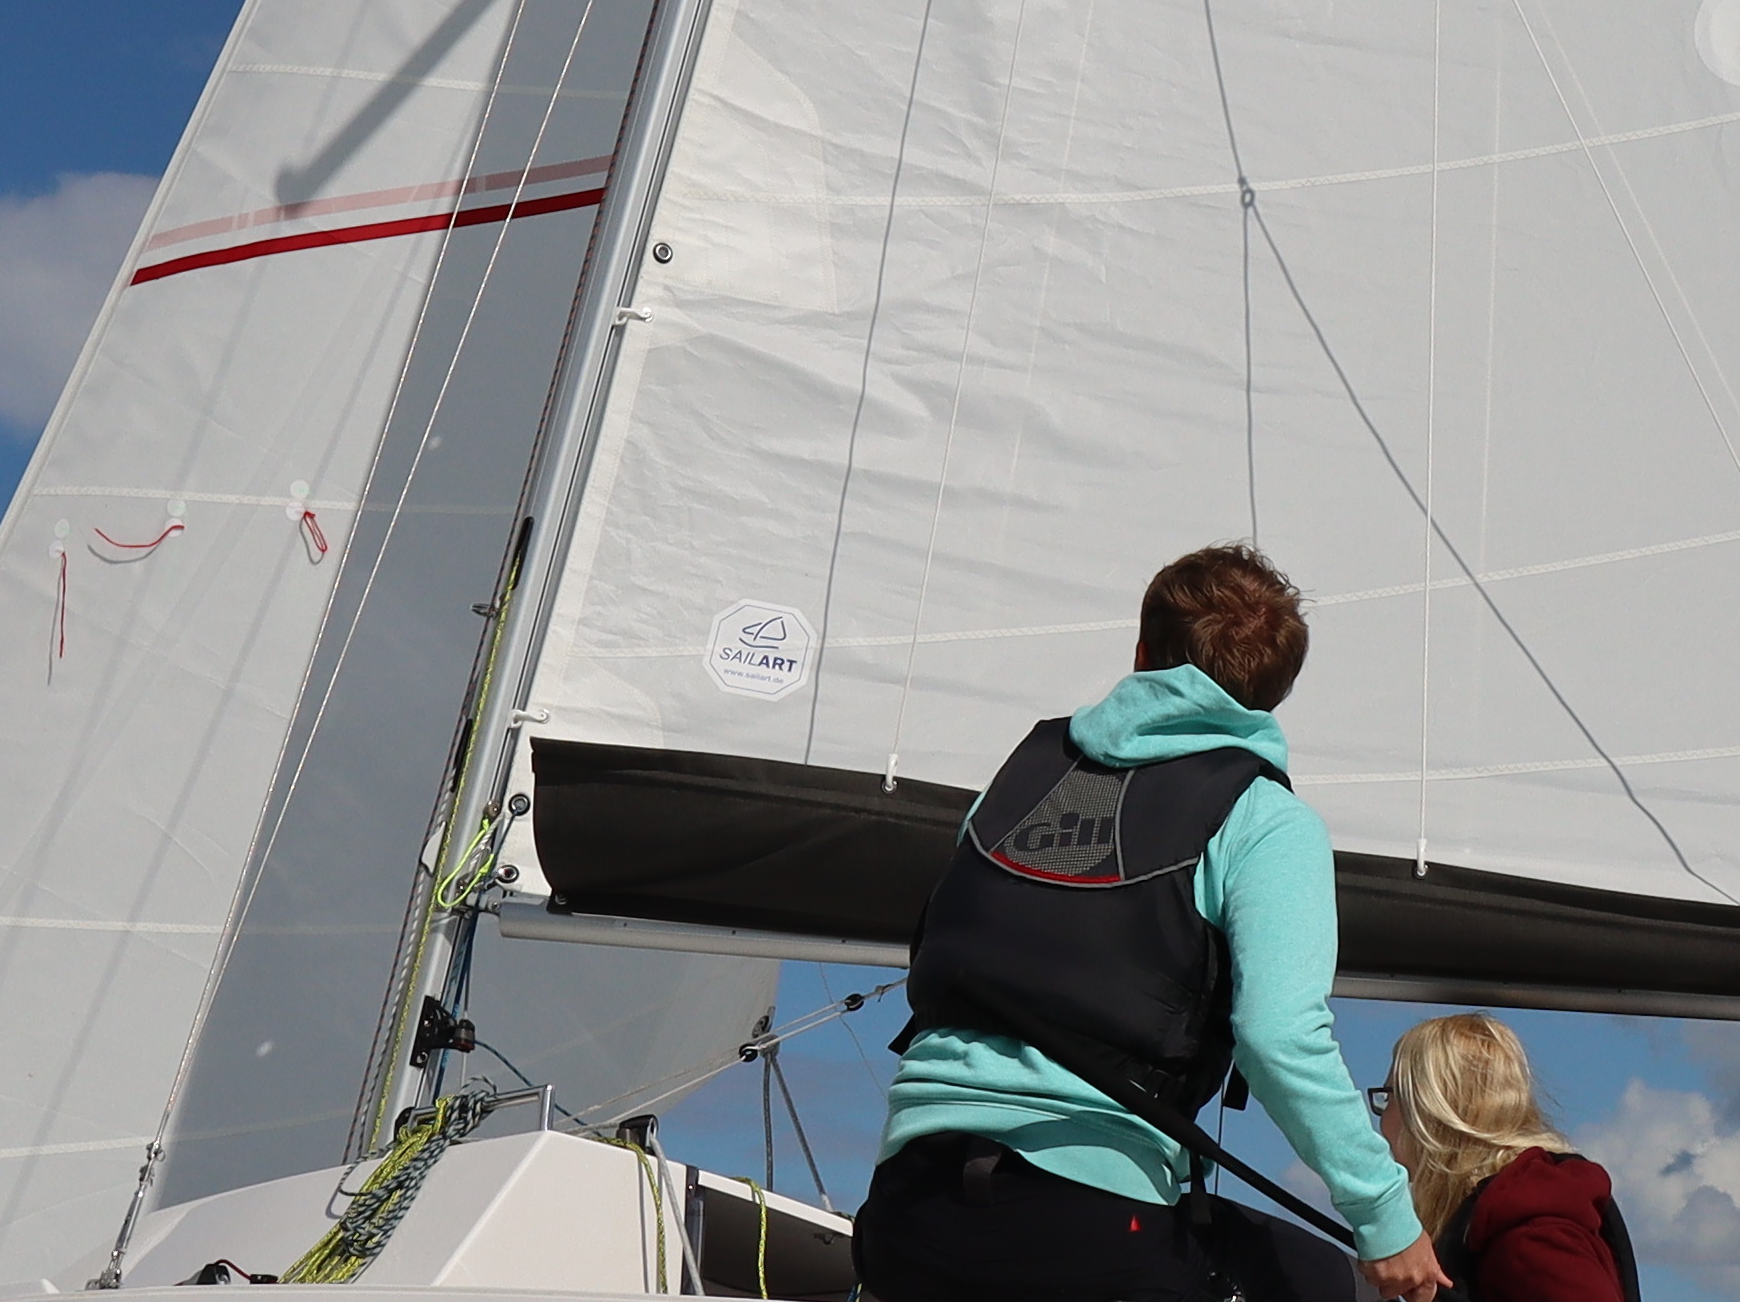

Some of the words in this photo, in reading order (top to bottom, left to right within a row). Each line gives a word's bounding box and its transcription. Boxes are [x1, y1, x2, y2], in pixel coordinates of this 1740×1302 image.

[719, 647, 797, 673] SAILART
[723, 668, 784, 684] www.sailart.de
[1012, 812, 1114, 852] Gill
